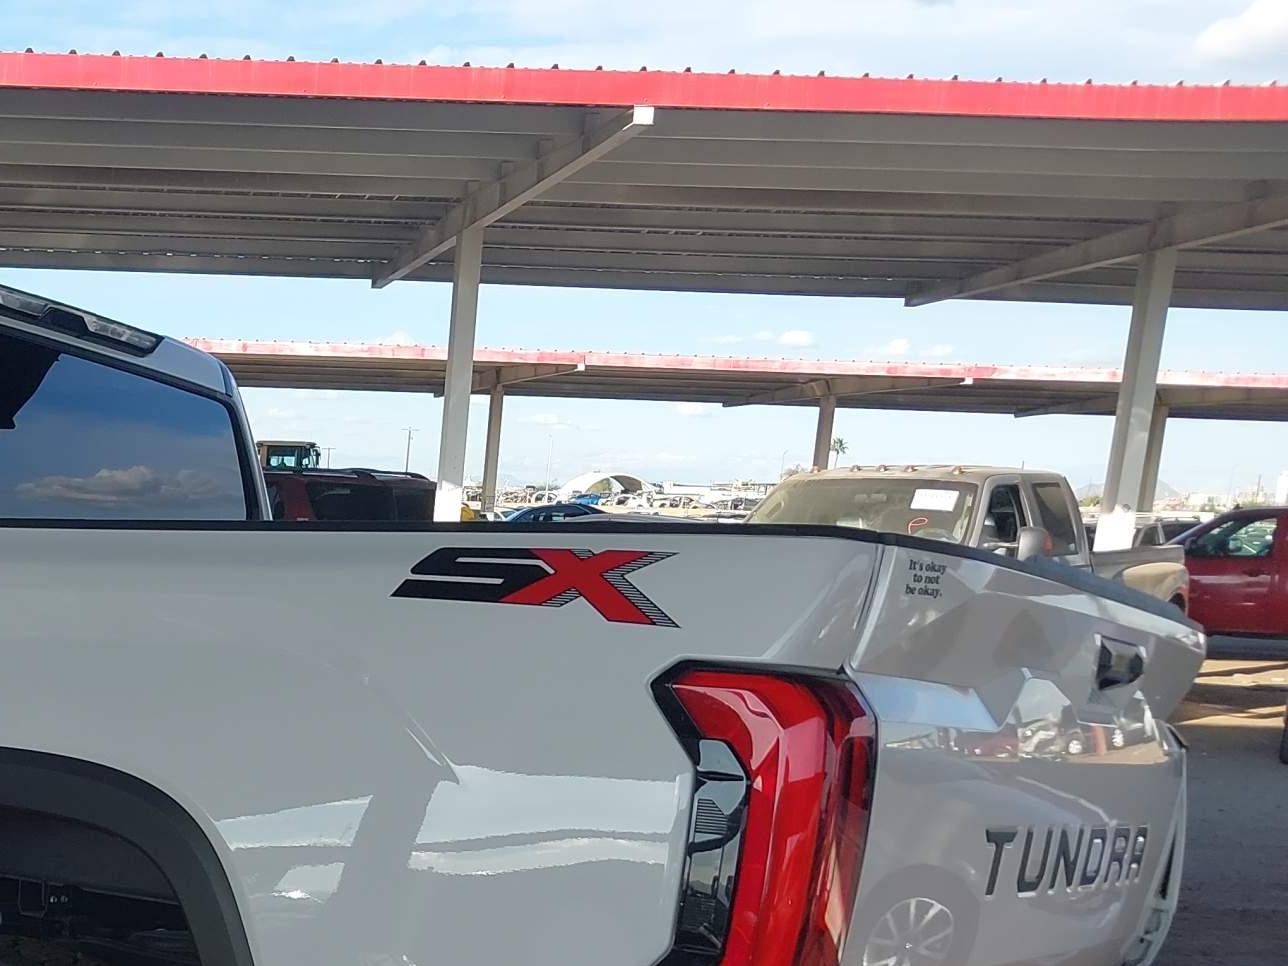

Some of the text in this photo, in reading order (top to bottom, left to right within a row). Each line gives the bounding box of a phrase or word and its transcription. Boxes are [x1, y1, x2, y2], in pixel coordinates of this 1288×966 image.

[908, 559, 947, 575] It's okay
[913, 573, 940, 584] to not
[389, 546, 681, 629] SX
[905, 583, 943, 598] be okay.
[984, 823, 1148, 899] TUNDRA
